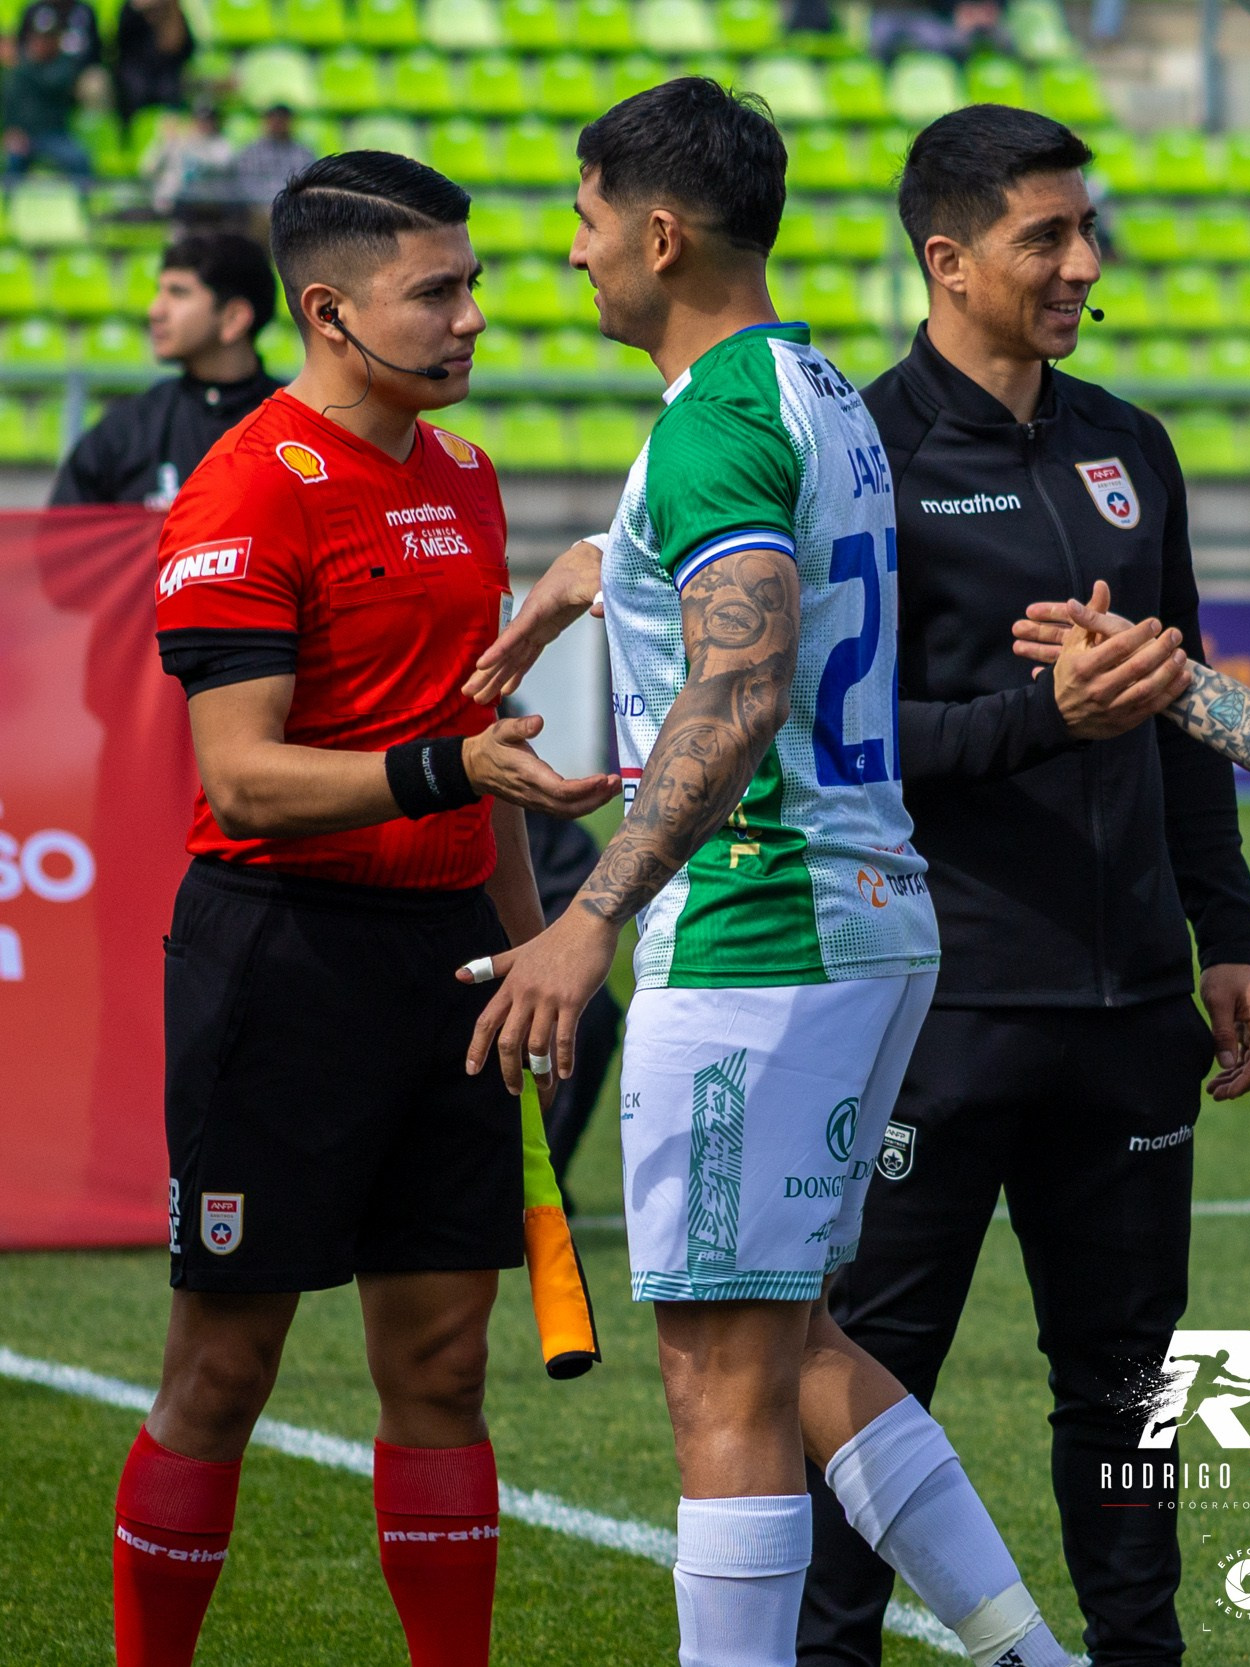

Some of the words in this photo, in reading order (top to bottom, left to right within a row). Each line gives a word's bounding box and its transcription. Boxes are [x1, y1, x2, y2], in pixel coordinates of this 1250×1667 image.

[385, 502, 457, 527] marathon
[921, 493, 1021, 514] marathon
[159, 548, 238, 597] LANCO
